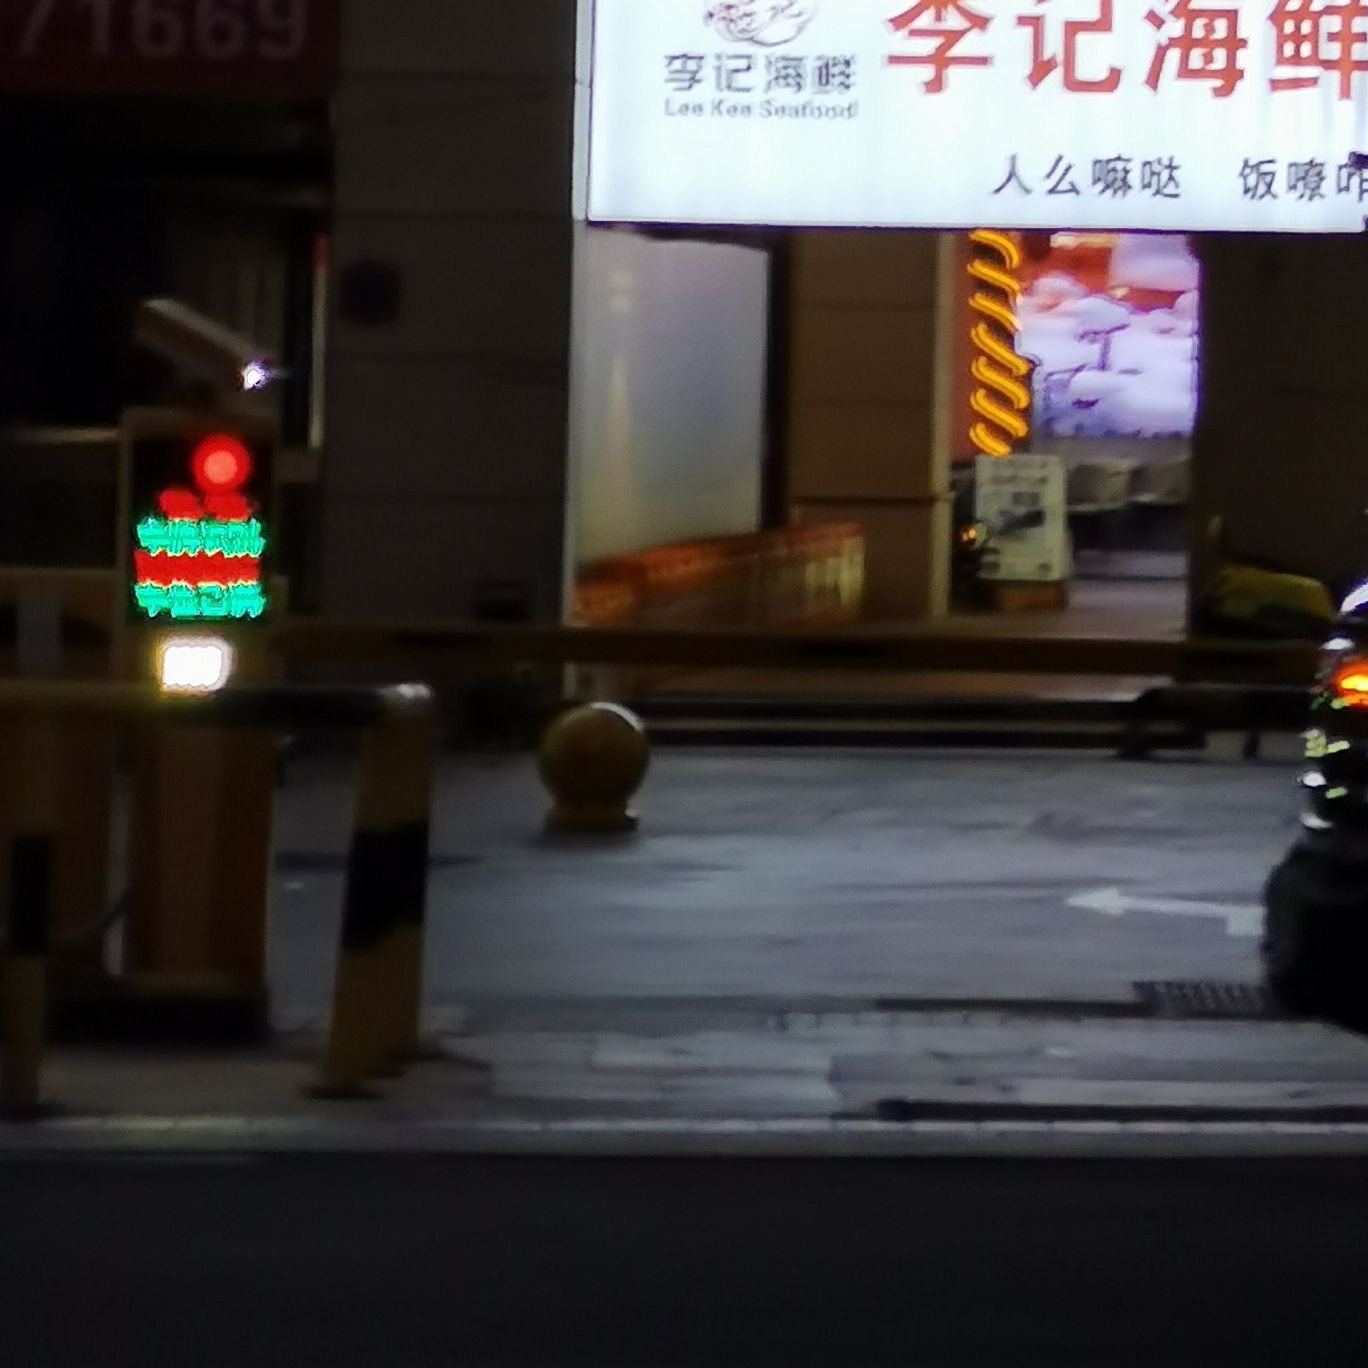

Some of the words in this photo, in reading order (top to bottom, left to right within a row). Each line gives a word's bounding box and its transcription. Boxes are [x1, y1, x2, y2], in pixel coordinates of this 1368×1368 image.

[664, 96, 705, 117] Lee
[711, 98, 752, 118] Kee
[758, 99, 858, 121] Seafood
[990, 153, 1182, 201] 人么嘛哒
